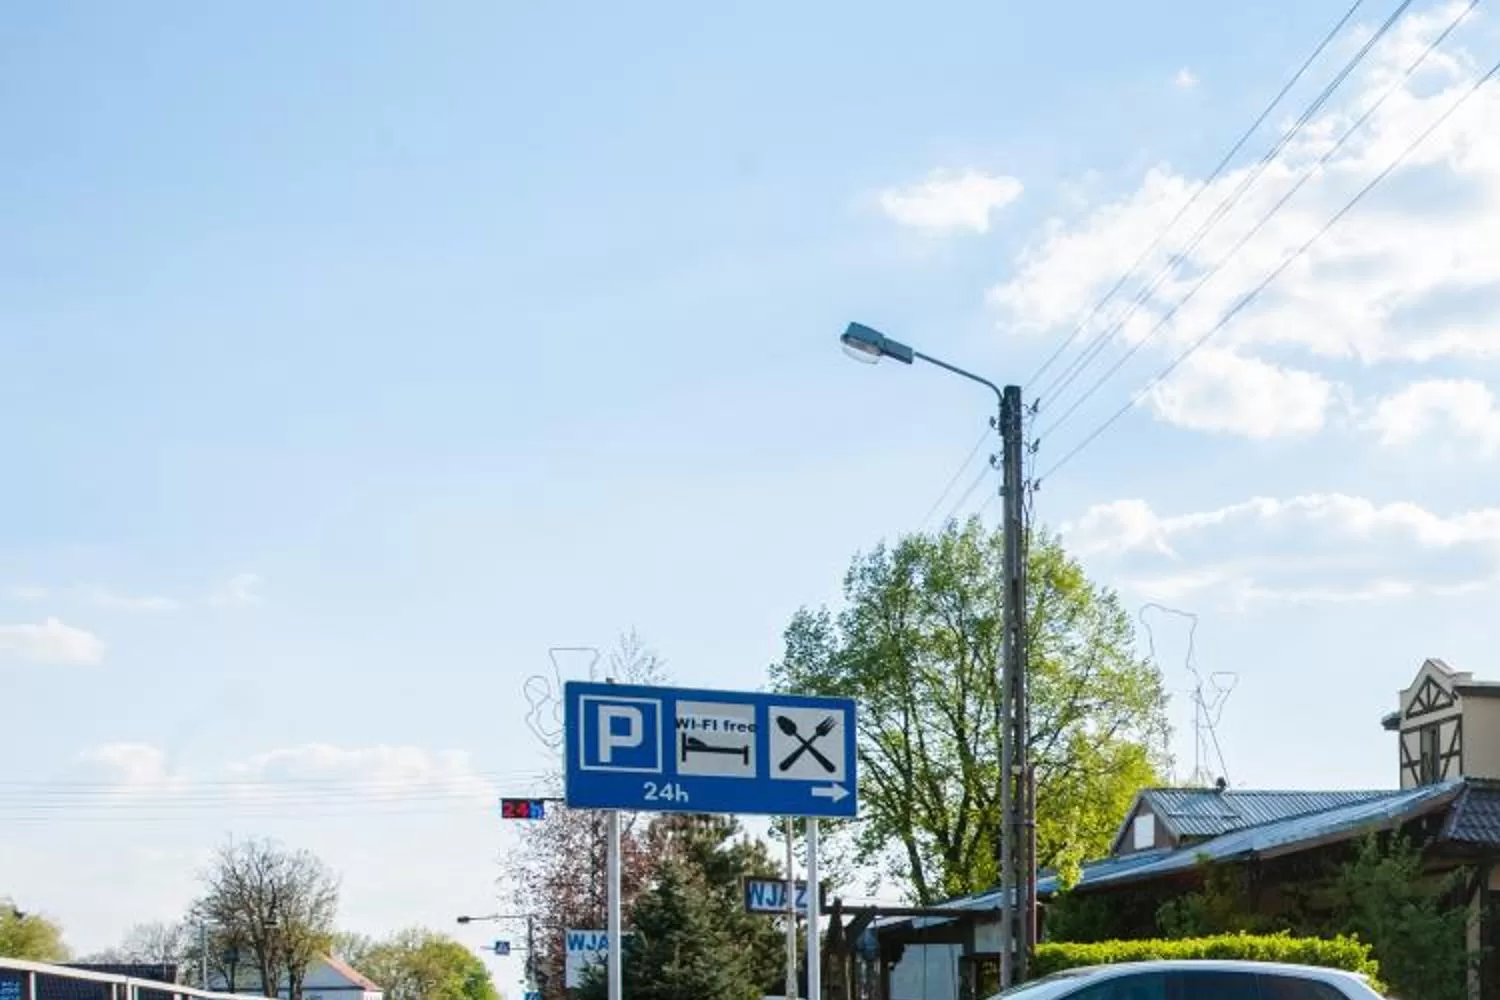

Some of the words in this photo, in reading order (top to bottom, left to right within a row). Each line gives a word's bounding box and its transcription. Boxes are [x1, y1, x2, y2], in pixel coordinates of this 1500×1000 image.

[598, 704, 643, 763] P
[724, 719, 757, 734] free
[643, 781, 689, 803] 24h
